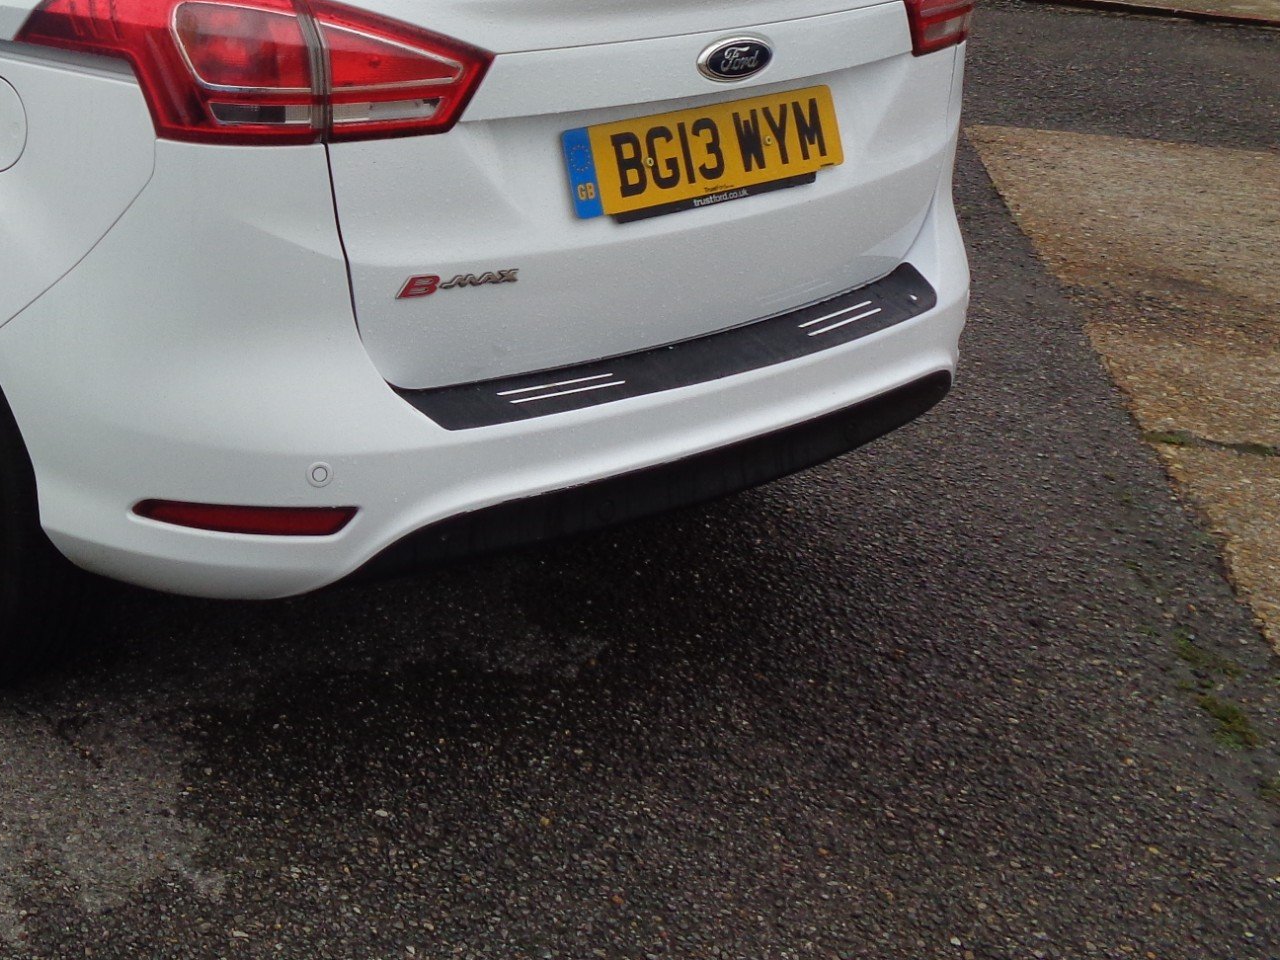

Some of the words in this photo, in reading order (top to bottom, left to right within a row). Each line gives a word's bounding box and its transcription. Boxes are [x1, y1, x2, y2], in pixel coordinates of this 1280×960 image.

[720, 46, 760, 72] Ford
[610, 117, 725, 198] BG13
[732, 98, 827, 172] WYM
[577, 182, 595, 200] GB
[693, 187, 749, 207] trustford.co.uk
